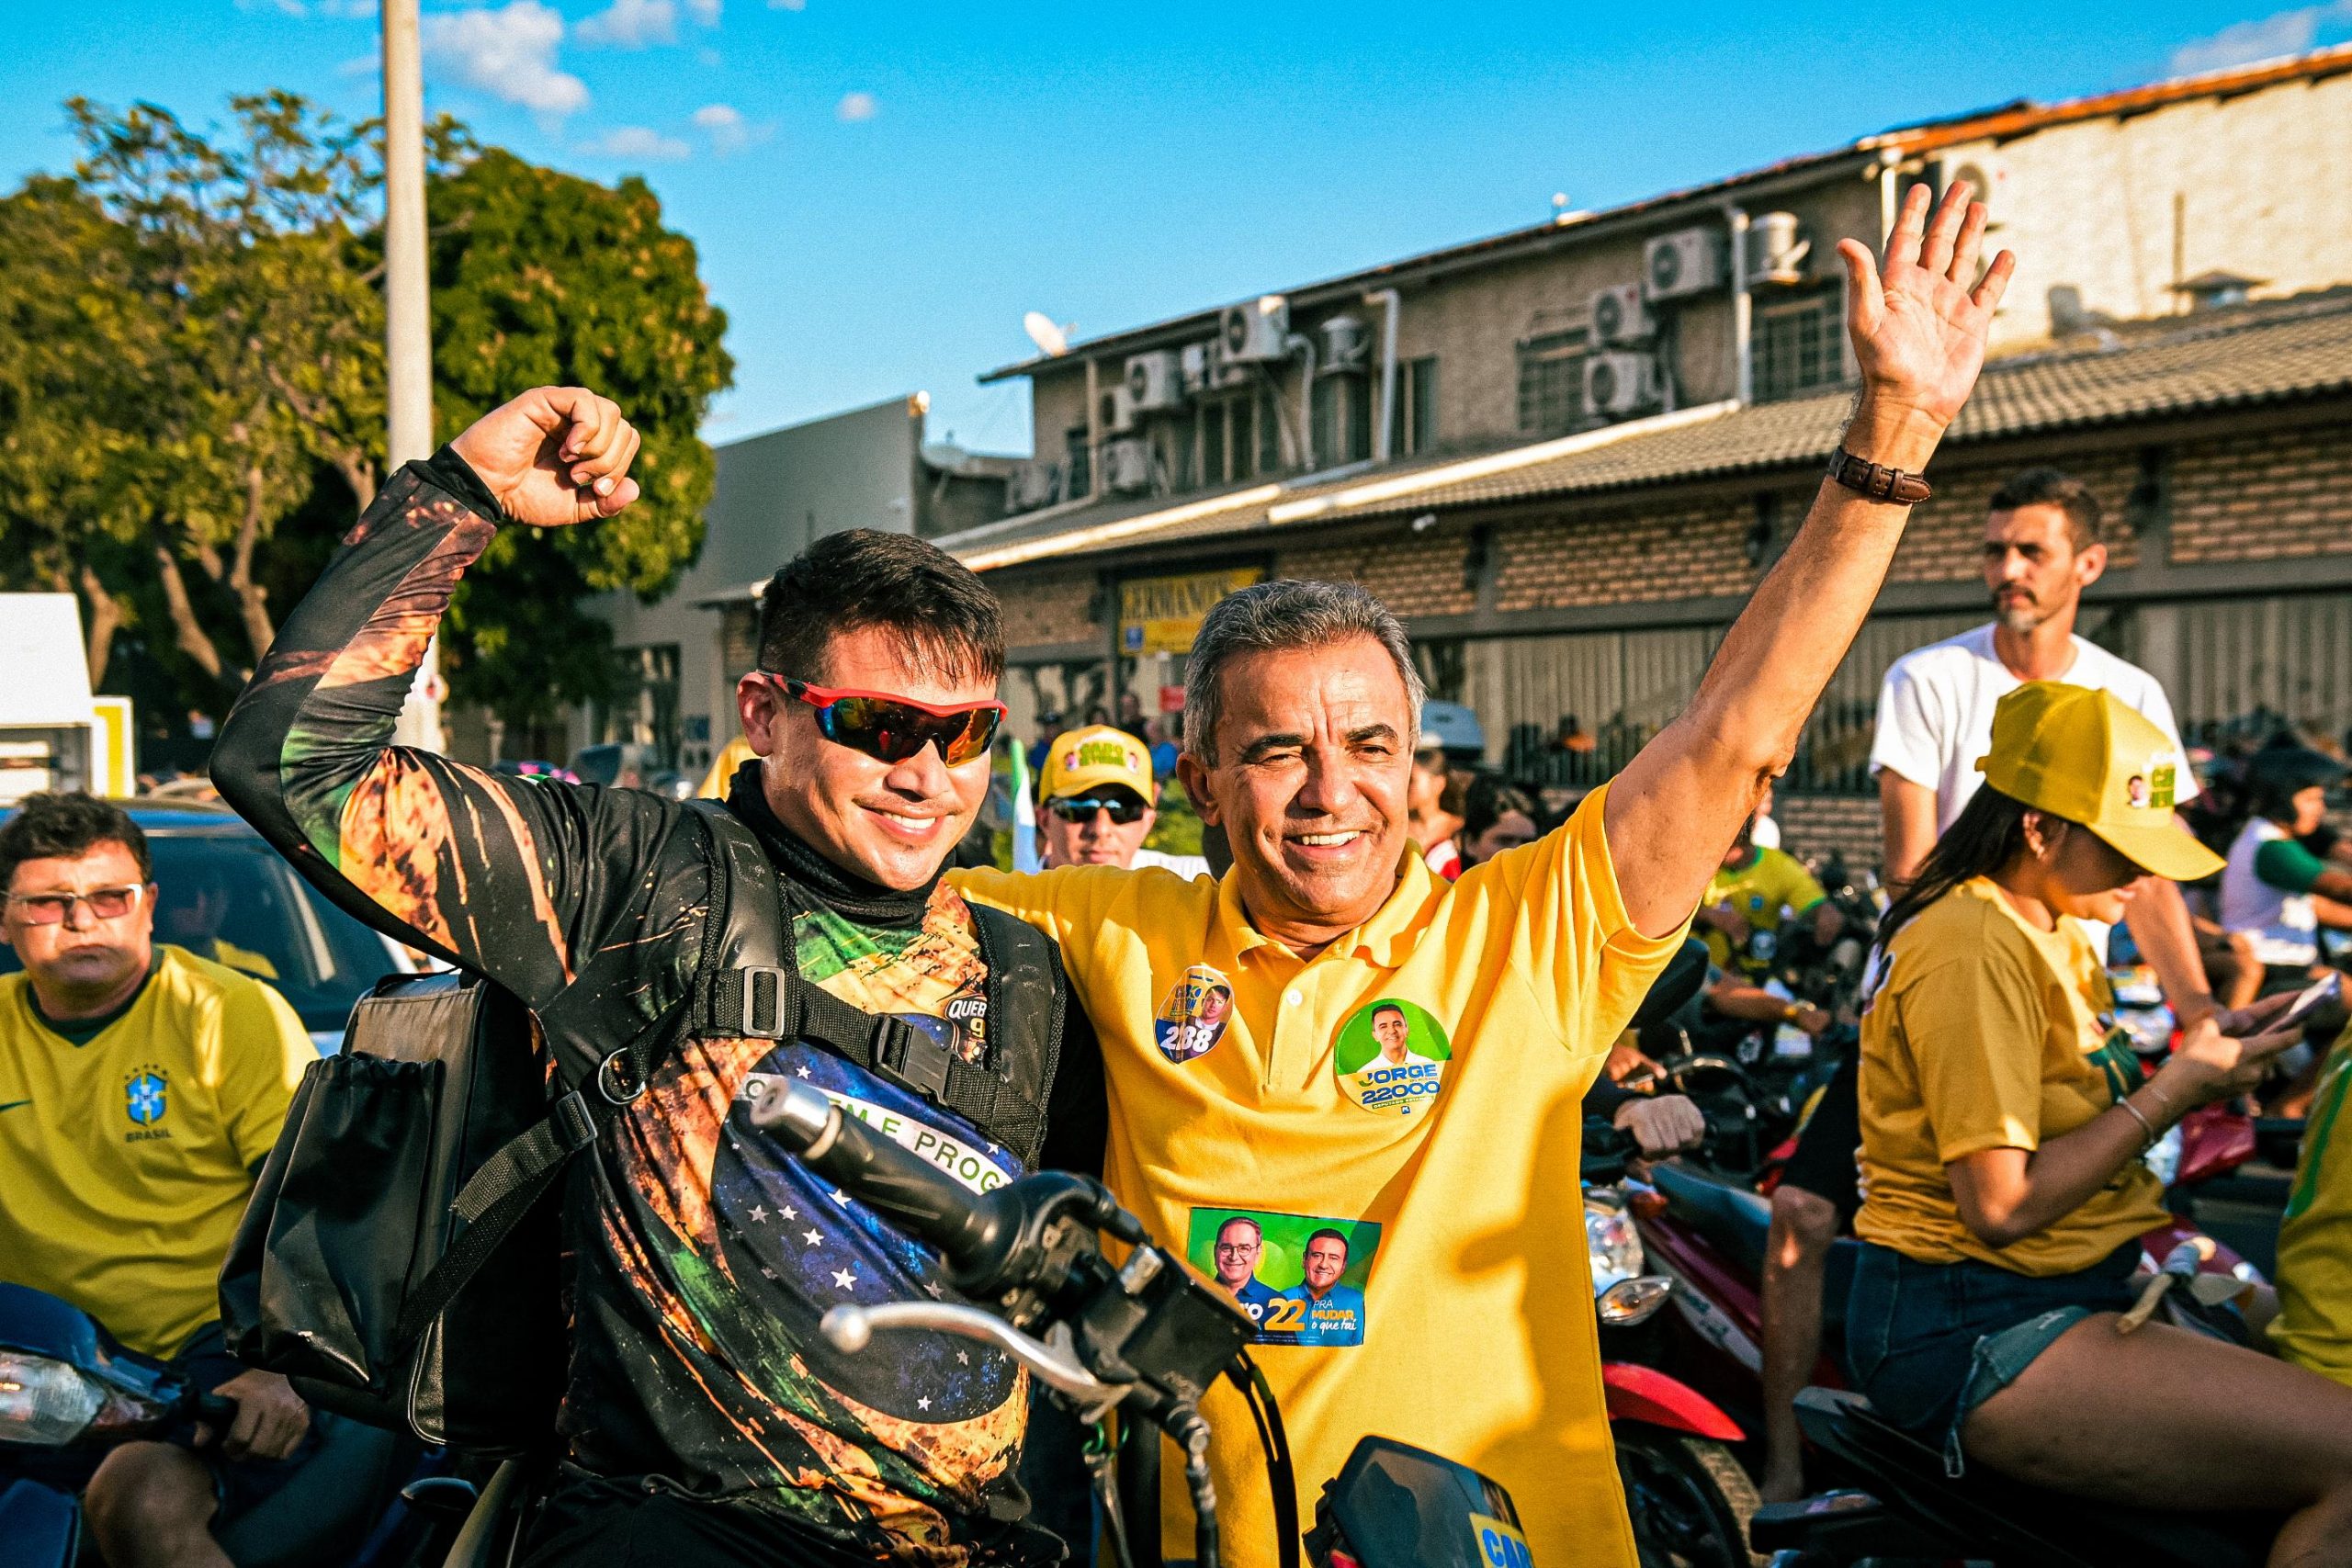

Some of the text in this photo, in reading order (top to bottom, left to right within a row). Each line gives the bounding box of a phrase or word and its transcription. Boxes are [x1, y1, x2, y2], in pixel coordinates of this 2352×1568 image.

[1358, 1064, 1437, 1087] JORGE
[1362, 1081, 1441, 1104] 22000
[125, 1128, 171, 1143] BRASIL
[1314, 1299, 1334, 1309] PRA
[1264, 1298, 1306, 1331] 22
[1312, 1310, 1354, 1320] MUDAR
[1319, 1321, 1340, 1336] que
